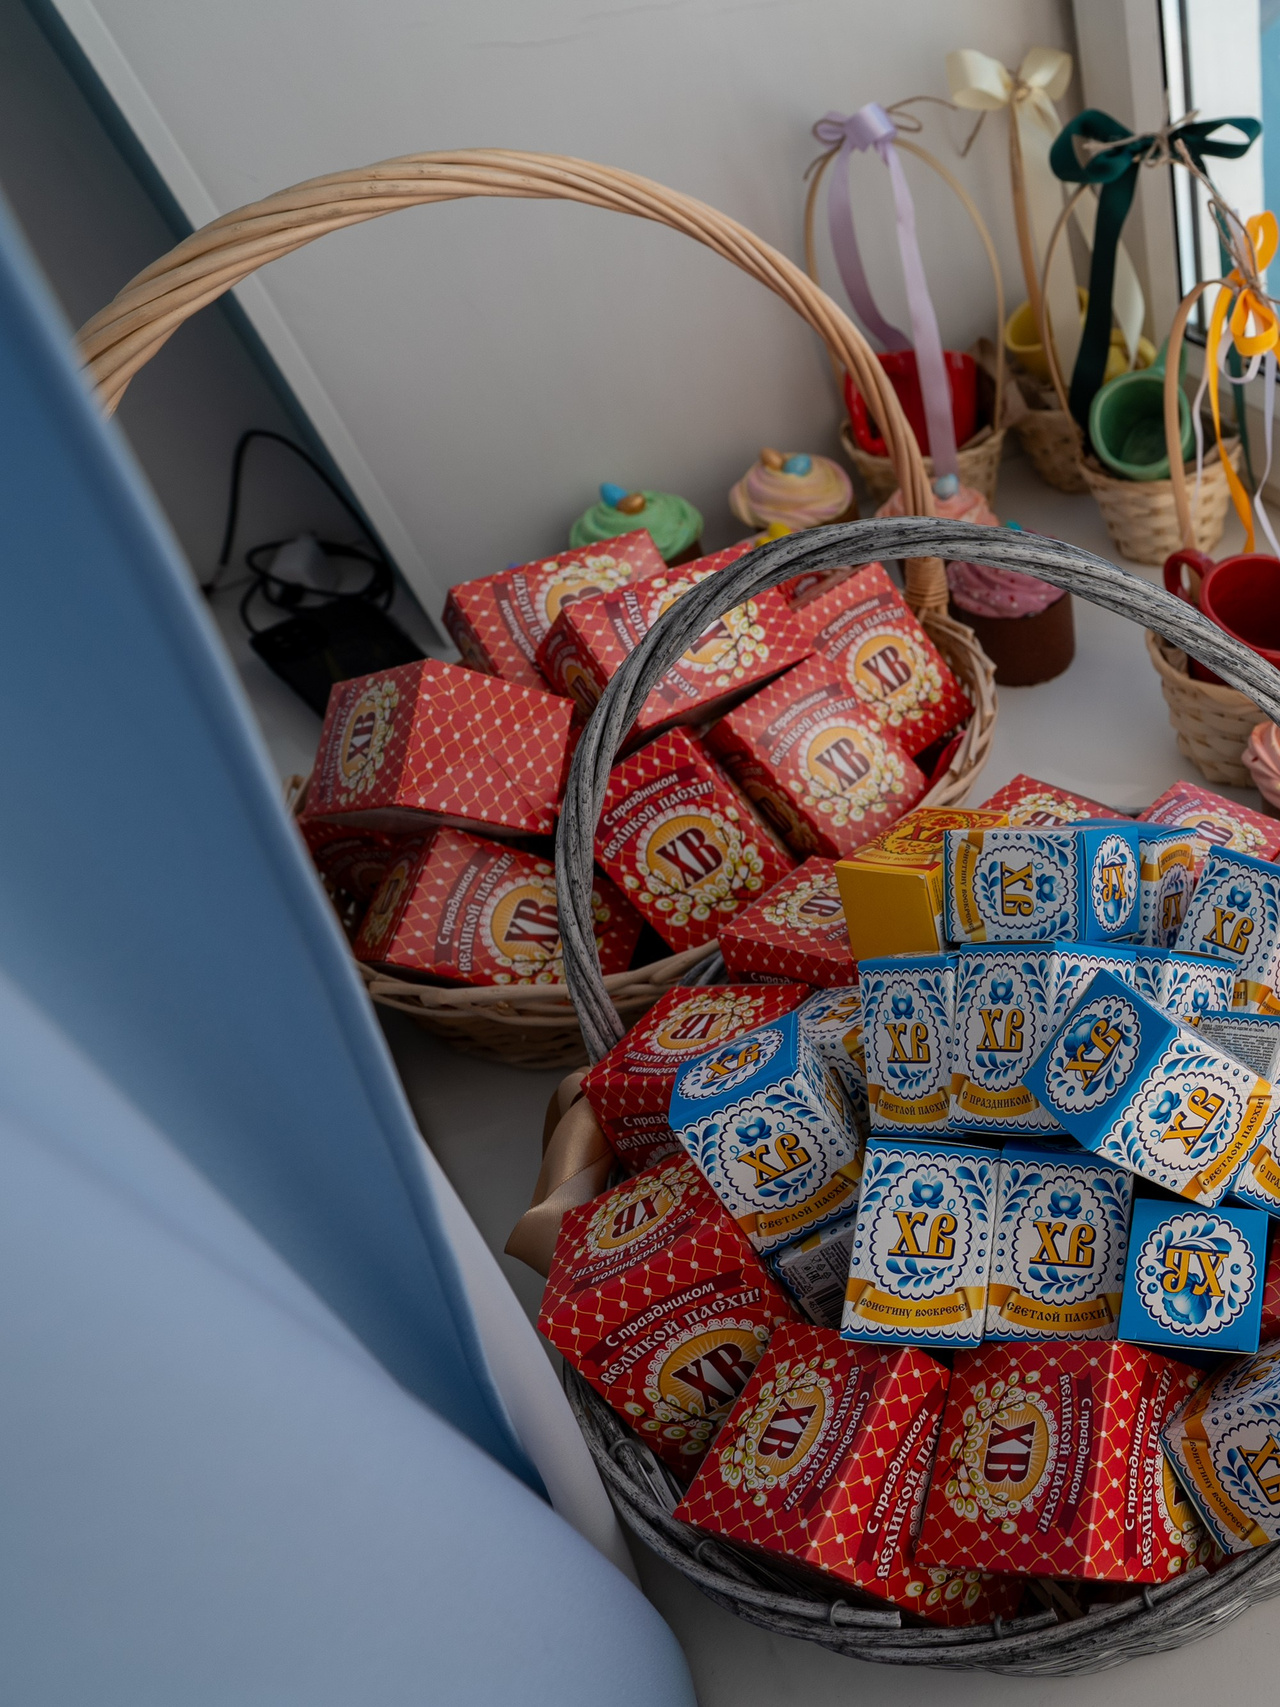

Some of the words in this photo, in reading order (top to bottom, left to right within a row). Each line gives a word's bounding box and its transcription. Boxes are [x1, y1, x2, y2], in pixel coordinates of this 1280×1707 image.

[821, 628, 832, 639] С
[831, 598, 881, 632] праздником
[825, 622, 864, 662] ЕЛИКОЙ
[864, 607, 906, 630] ПАСХИ!
[862, 646, 912, 697] ХВ
[346, 710, 376, 763] ХВ
[767, 725, 777, 736] С
[776, 690, 828, 729] праздником
[769, 712, 813, 767] ВЕЛИКОЙ
[810, 697, 857, 721] ПАСХИ!
[815, 736, 871, 792] ХВ
[603, 816, 613, 826] С
[610, 774, 679, 819] праздником
[603, 804, 658, 860] ВЕЛИКОЙ
[658, 781, 714, 810] ПАСХИ!
[655, 828, 723, 889] ХВ
[1102, 863, 1127, 903] ХВ
[441, 864, 478, 937] праздником
[459, 904, 482, 972] ВЕЛИКОЙ
[475, 853, 514, 903] ПАСХИ!
[1000, 861, 1034, 917] ХВ
[438, 936, 448, 945] С
[504, 899, 560, 953] ХВ
[1204, 907, 1253, 954] ХВ
[670, 1014, 724, 1039] ХВ
[885, 1023, 930, 1063] ХВ
[976, 1009, 1024, 1052] ХВ
[703, 1044, 760, 1083] ХВ
[1064, 1020, 1122, 1090] ХВ
[624, 1117, 632, 1127] С
[878, 1099, 917, 1116] СВЕТЛОЙ
[918, 1100, 949, 1116] ПАСХИ!
[962, 1090, 968, 1100] С
[969, 1092, 1034, 1110] ПРАЗДНИКОМ!
[1159, 1088, 1224, 1156] ХВ
[737, 1133, 812, 1189] ХВ
[1202, 1139, 1243, 1188] СВЕТЛОЙ
[1240, 1097, 1265, 1142] ПАСХИ!
[1259, 1163, 1266, 1173] С
[611, 1192, 660, 1239] ХВ
[631, 1207, 697, 1253] ВЕЛИКОЙ
[759, 1206, 815, 1231] СВЕТЛОЙ
[815, 1179, 850, 1212] ПАСХИ!
[591, 1238, 666, 1285] праздником
[667, 1235, 676, 1244] С
[888, 1211, 958, 1260] ХВ
[1030, 1221, 1097, 1268] ХВ
[572, 1249, 625, 1280] ПАСХИ!
[1162, 1247, 1230, 1298] ХВ
[605, 1335, 618, 1347] С
[616, 1281, 715, 1340] праздником
[859, 1298, 913, 1319] ВОИСТИНУ
[915, 1302, 968, 1317] ВОСКРЕСЕ!
[1006, 1302, 1060, 1323] СВЕТЛОЙ
[1065, 1307, 1108, 1323] ПАСХИ!
[601, 1320, 682, 1386] ВЕЛИКОЙ
[683, 1288, 761, 1327] ПАСХИ!
[671, 1344, 756, 1414] ХВ
[827, 1366, 860, 1443] ВЕЛИКОЙ
[861, 1391, 870, 1400] С
[1083, 1397, 1093, 1407] С
[758, 1399, 817, 1459] ХВ
[1059, 1374, 1074, 1460] ВЕЛИКОЙ
[1148, 1369, 1172, 1451] ПАСХИ!
[817, 1400, 863, 1490] праздником
[866, 1520, 878, 1534] С
[874, 1408, 929, 1519] праздником
[983, 1420, 1036, 1484] ХВ
[1068, 1409, 1091, 1505] праздником
[1127, 1396, 1149, 1514] праздником
[1188, 1440, 1214, 1490] ВОИСТИНУ
[785, 1442, 829, 1510] ПАСХИ!
[1038, 1462, 1069, 1535] ПАСХИ!
[876, 1470, 920, 1578] ВЕЛИКОЙ
[1124, 1518, 1135, 1531] С
[1143, 1457, 1157, 1568] ВЕЛИКОЙ
